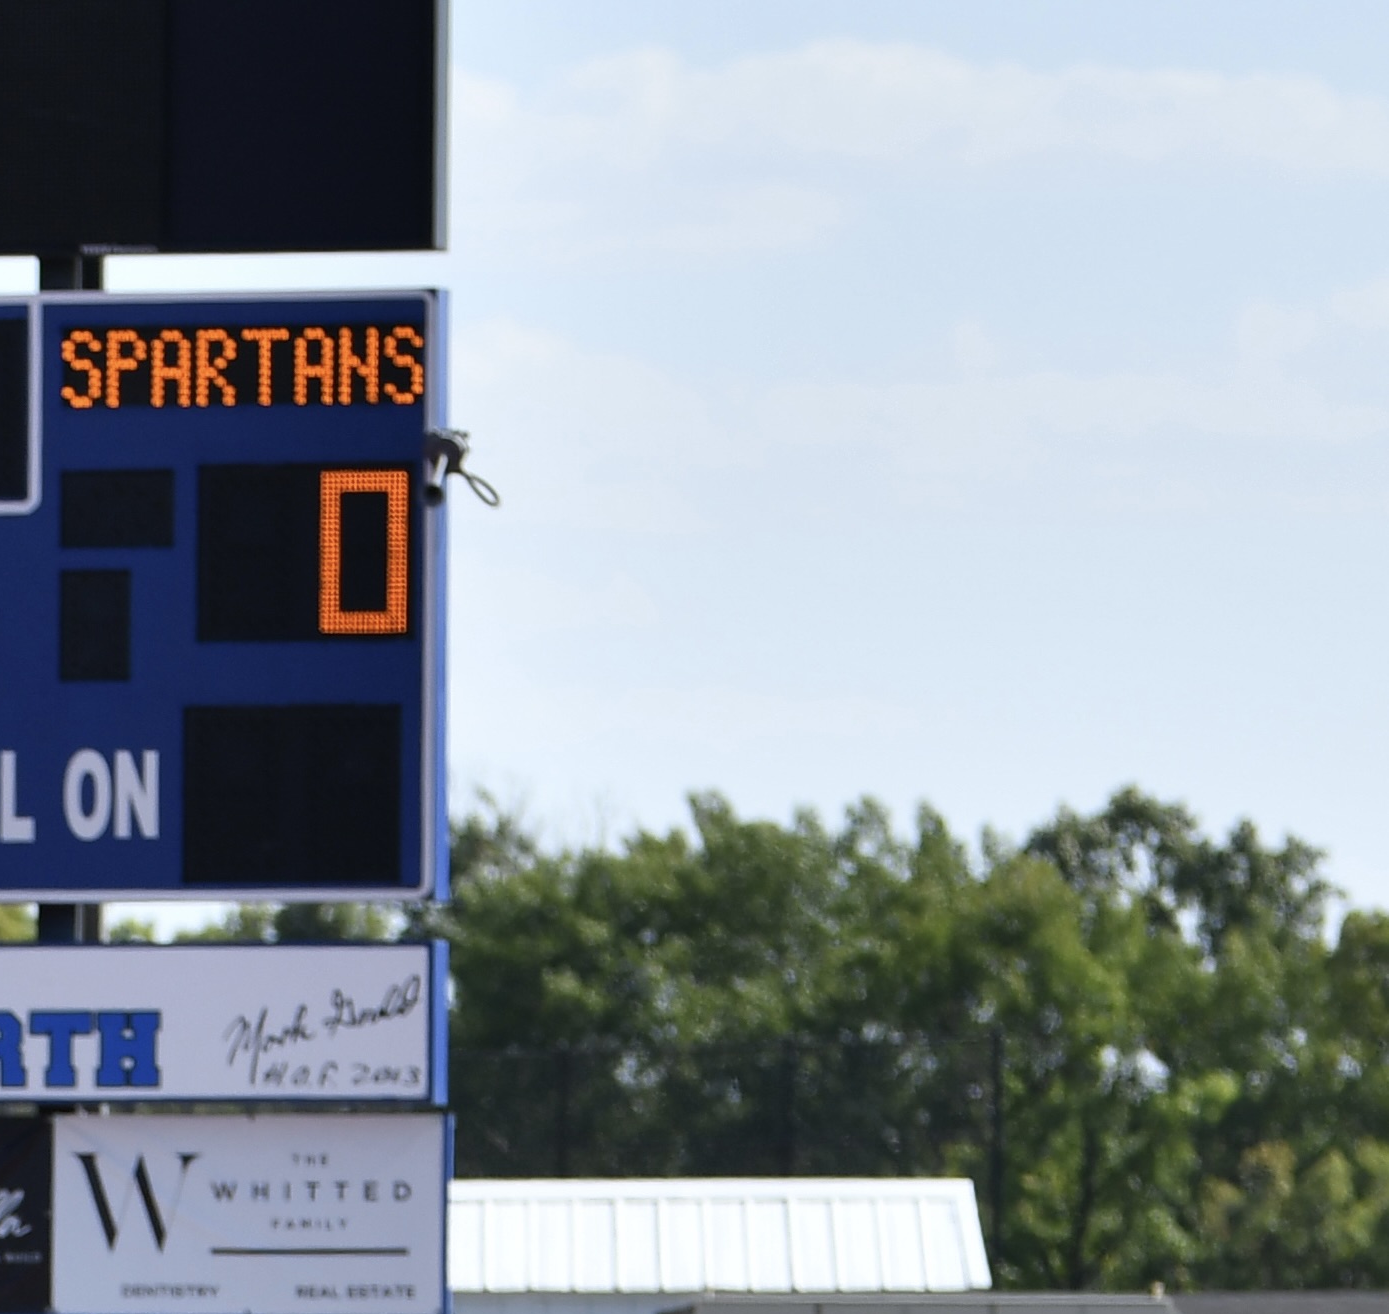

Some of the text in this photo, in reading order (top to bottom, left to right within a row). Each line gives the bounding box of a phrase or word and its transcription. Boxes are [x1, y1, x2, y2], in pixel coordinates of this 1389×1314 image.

[61, 326, 424, 408] SPARTANS
[319, 470, 409, 635] 0
[63, 749, 160, 840] ON
[292, 1153, 330, 1168] THE
[72, 1151, 202, 1253] W
[212, 1180, 413, 1202] WHITTED
[270, 1217, 349, 1232] FAMILY
[121, 1283, 220, 1299] DENTISTRY
[295, 1283, 418, 1299] REAL ESTATE
